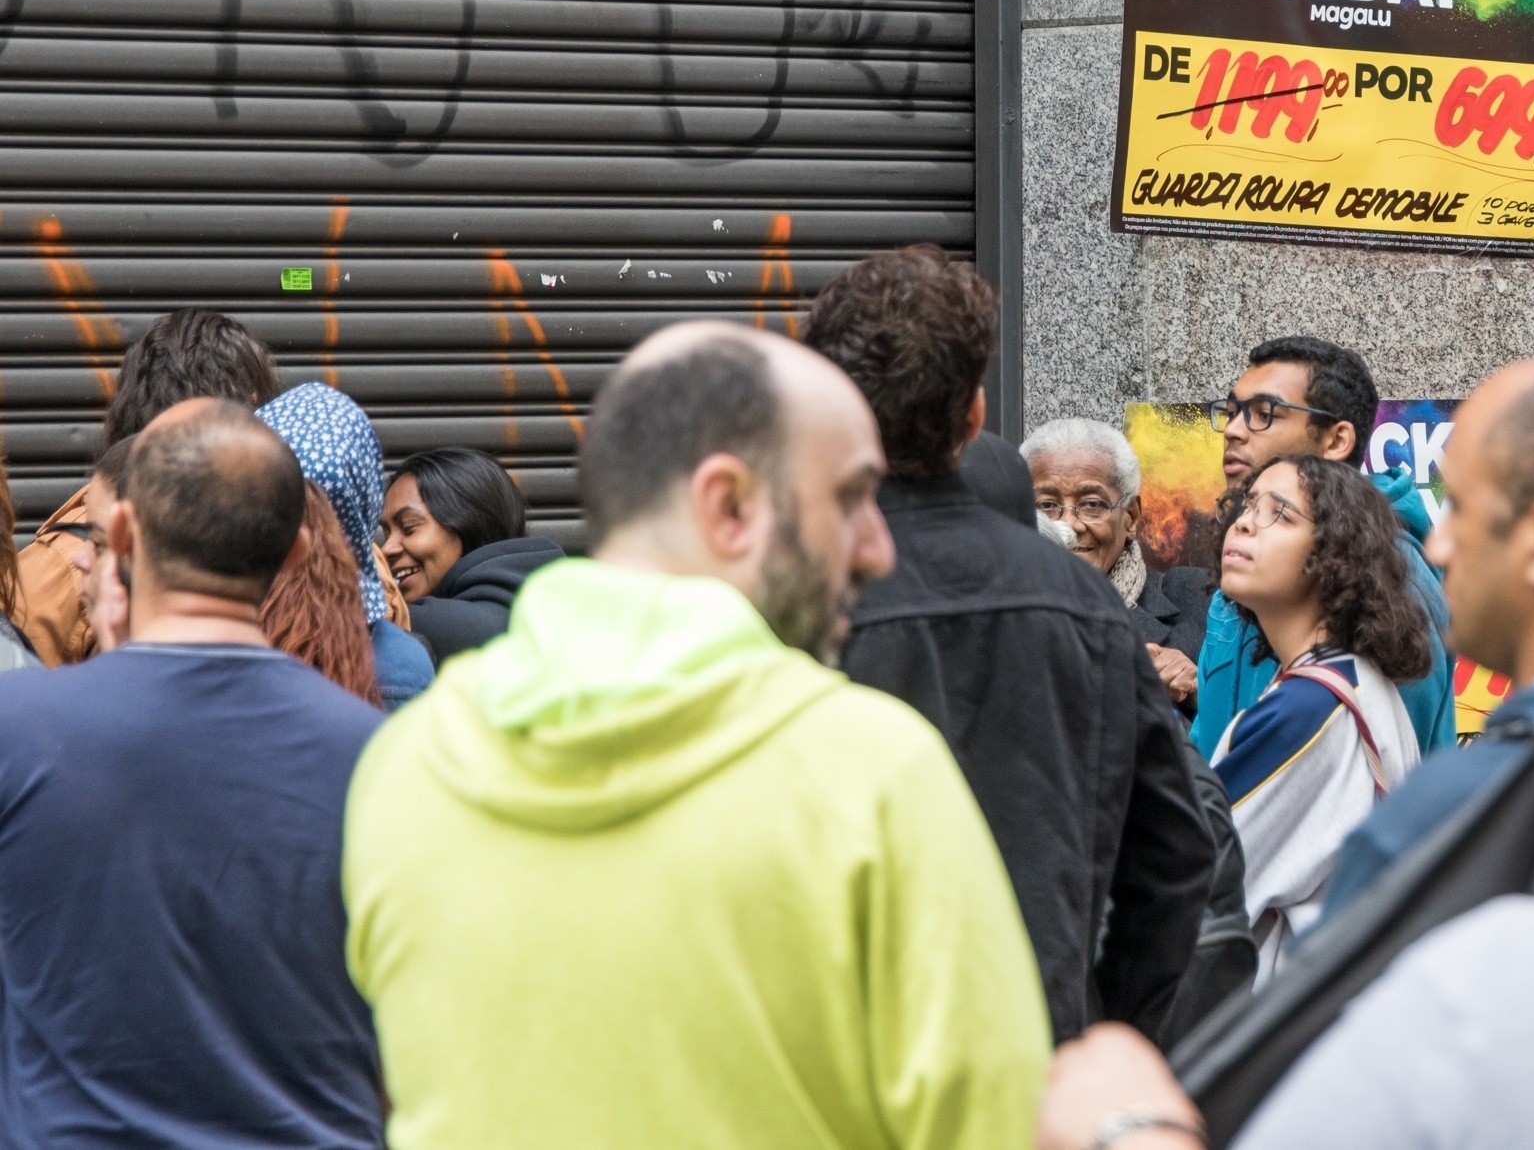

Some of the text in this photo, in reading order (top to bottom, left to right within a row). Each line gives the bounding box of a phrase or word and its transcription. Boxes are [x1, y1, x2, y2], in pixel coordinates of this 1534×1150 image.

[1143, 44, 1191, 84] DE
[1355, 62, 1433, 103] POR
[1131, 168, 1470, 222] GUARDA ROUPA DEMOBILE
[1483, 196, 1504, 209] 10
[1477, 212, 1494, 225] 3
[1306, 227, 1326, 235] promoção
